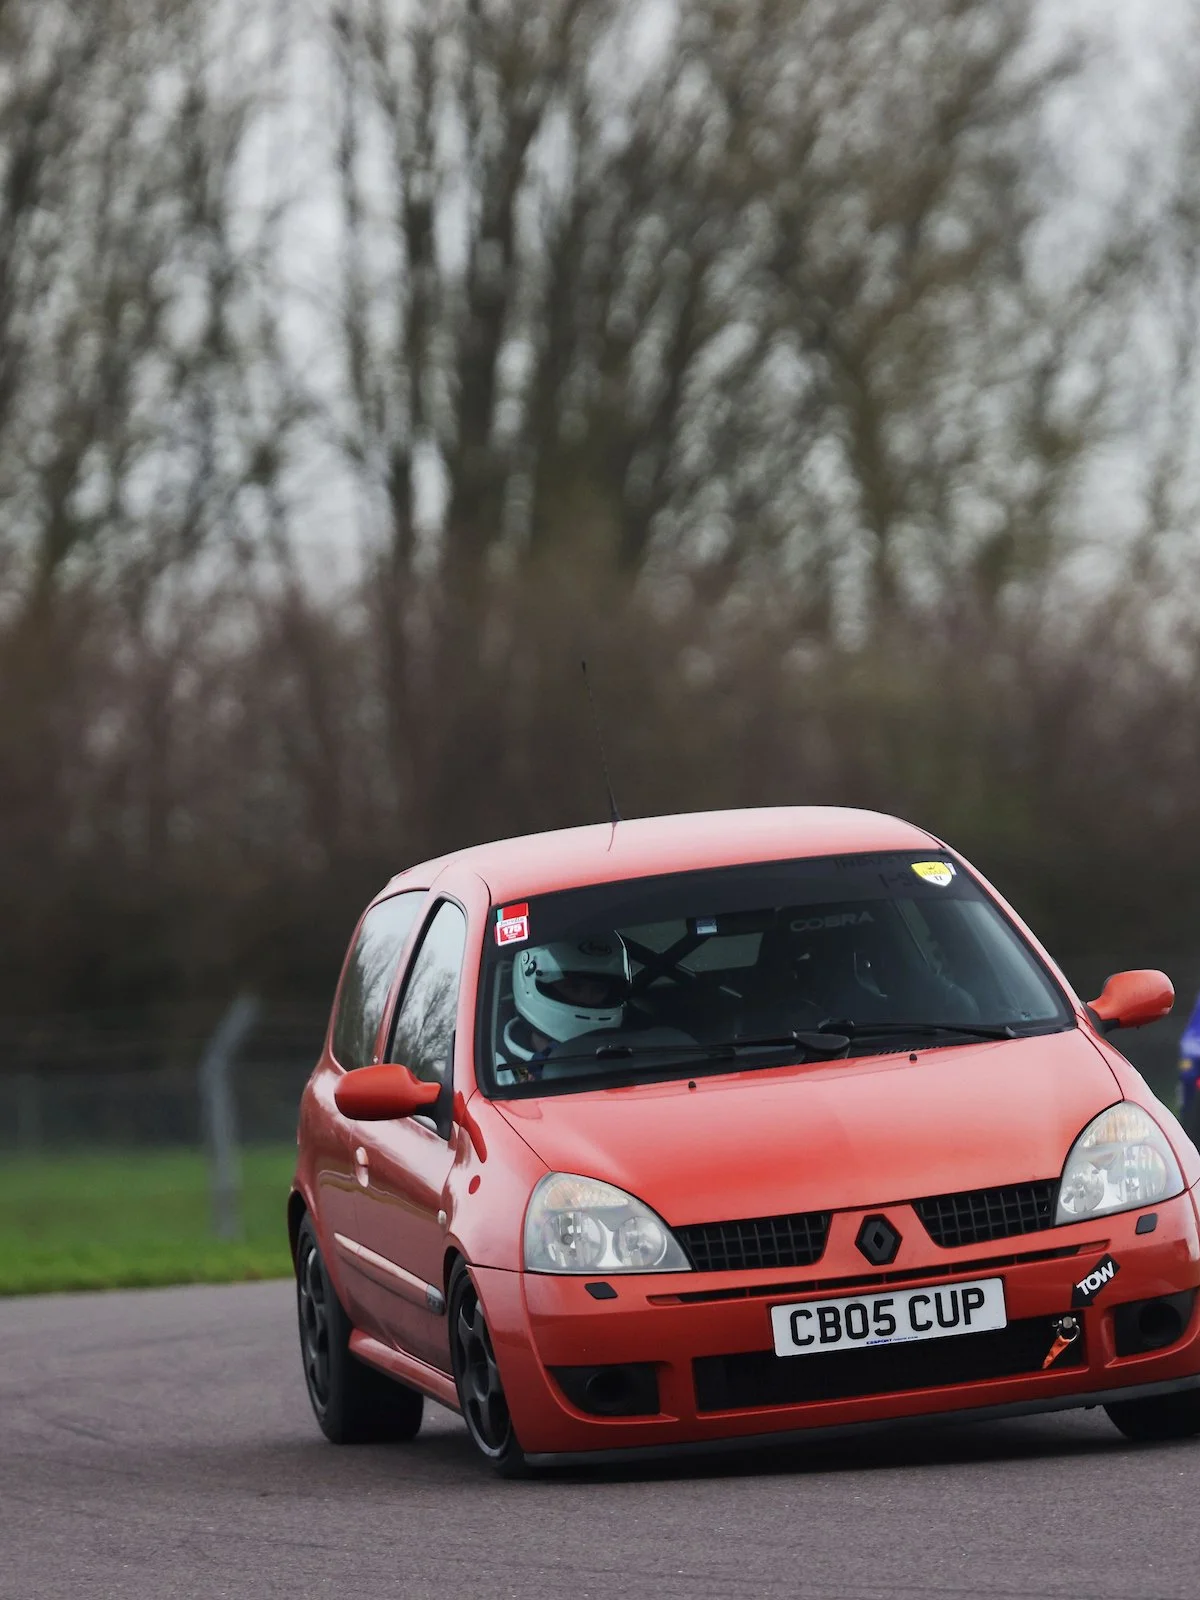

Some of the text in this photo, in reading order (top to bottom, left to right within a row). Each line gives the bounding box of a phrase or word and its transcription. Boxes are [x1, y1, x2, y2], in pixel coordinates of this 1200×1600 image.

[790, 911, 875, 931] COBRA
[1076, 1261, 1114, 1295] TOW
[789, 1287, 985, 1347] CB05 CUP
